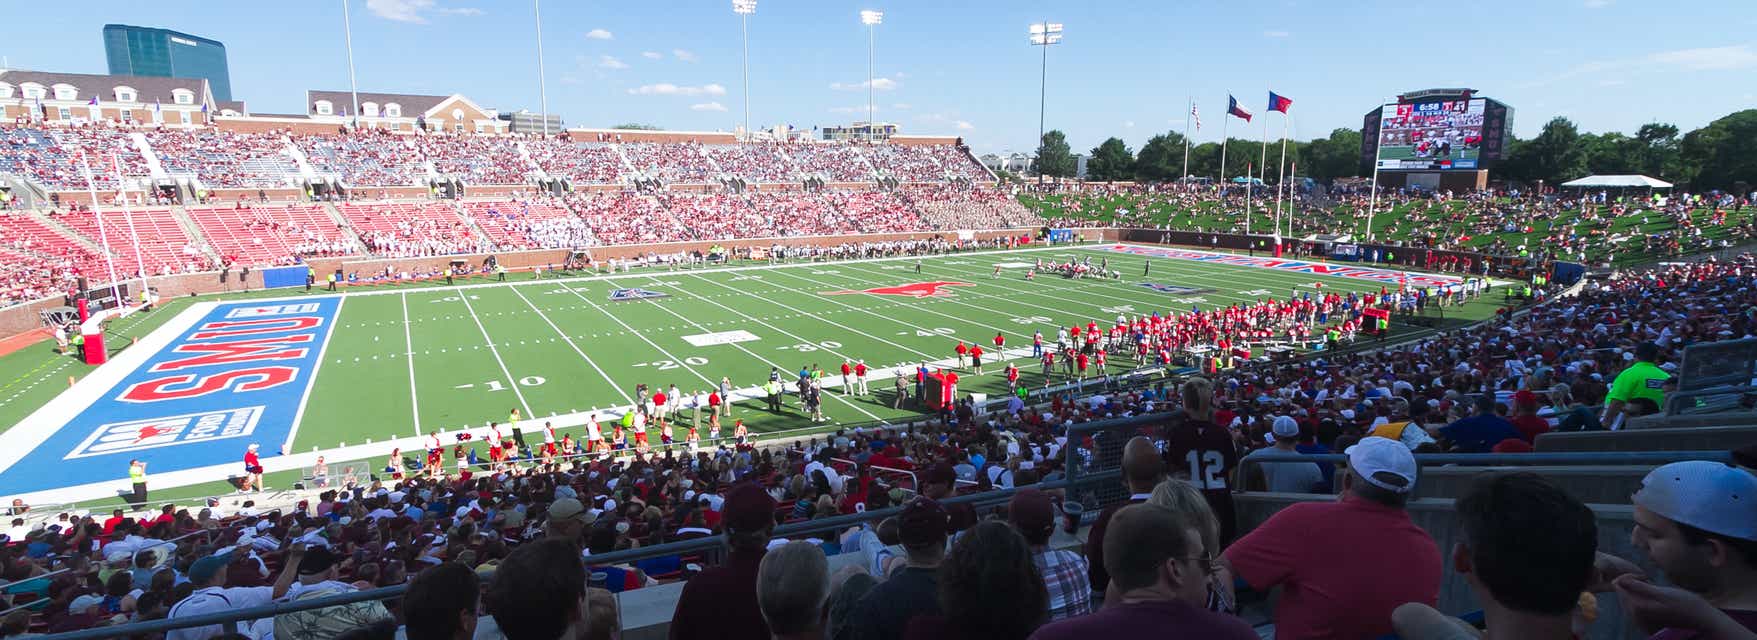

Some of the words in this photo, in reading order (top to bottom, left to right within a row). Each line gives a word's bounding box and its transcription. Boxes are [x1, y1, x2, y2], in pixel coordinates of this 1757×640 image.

[1420, 103, 1439, 111] 6:58
[1453, 102, 1466, 112] 41
[793, 341, 842, 351] 30
[113, 317, 325, 404] SMU
[652, 357, 709, 370] 20
[484, 376, 545, 392] 10
[1185, 449, 1227, 490] 12
